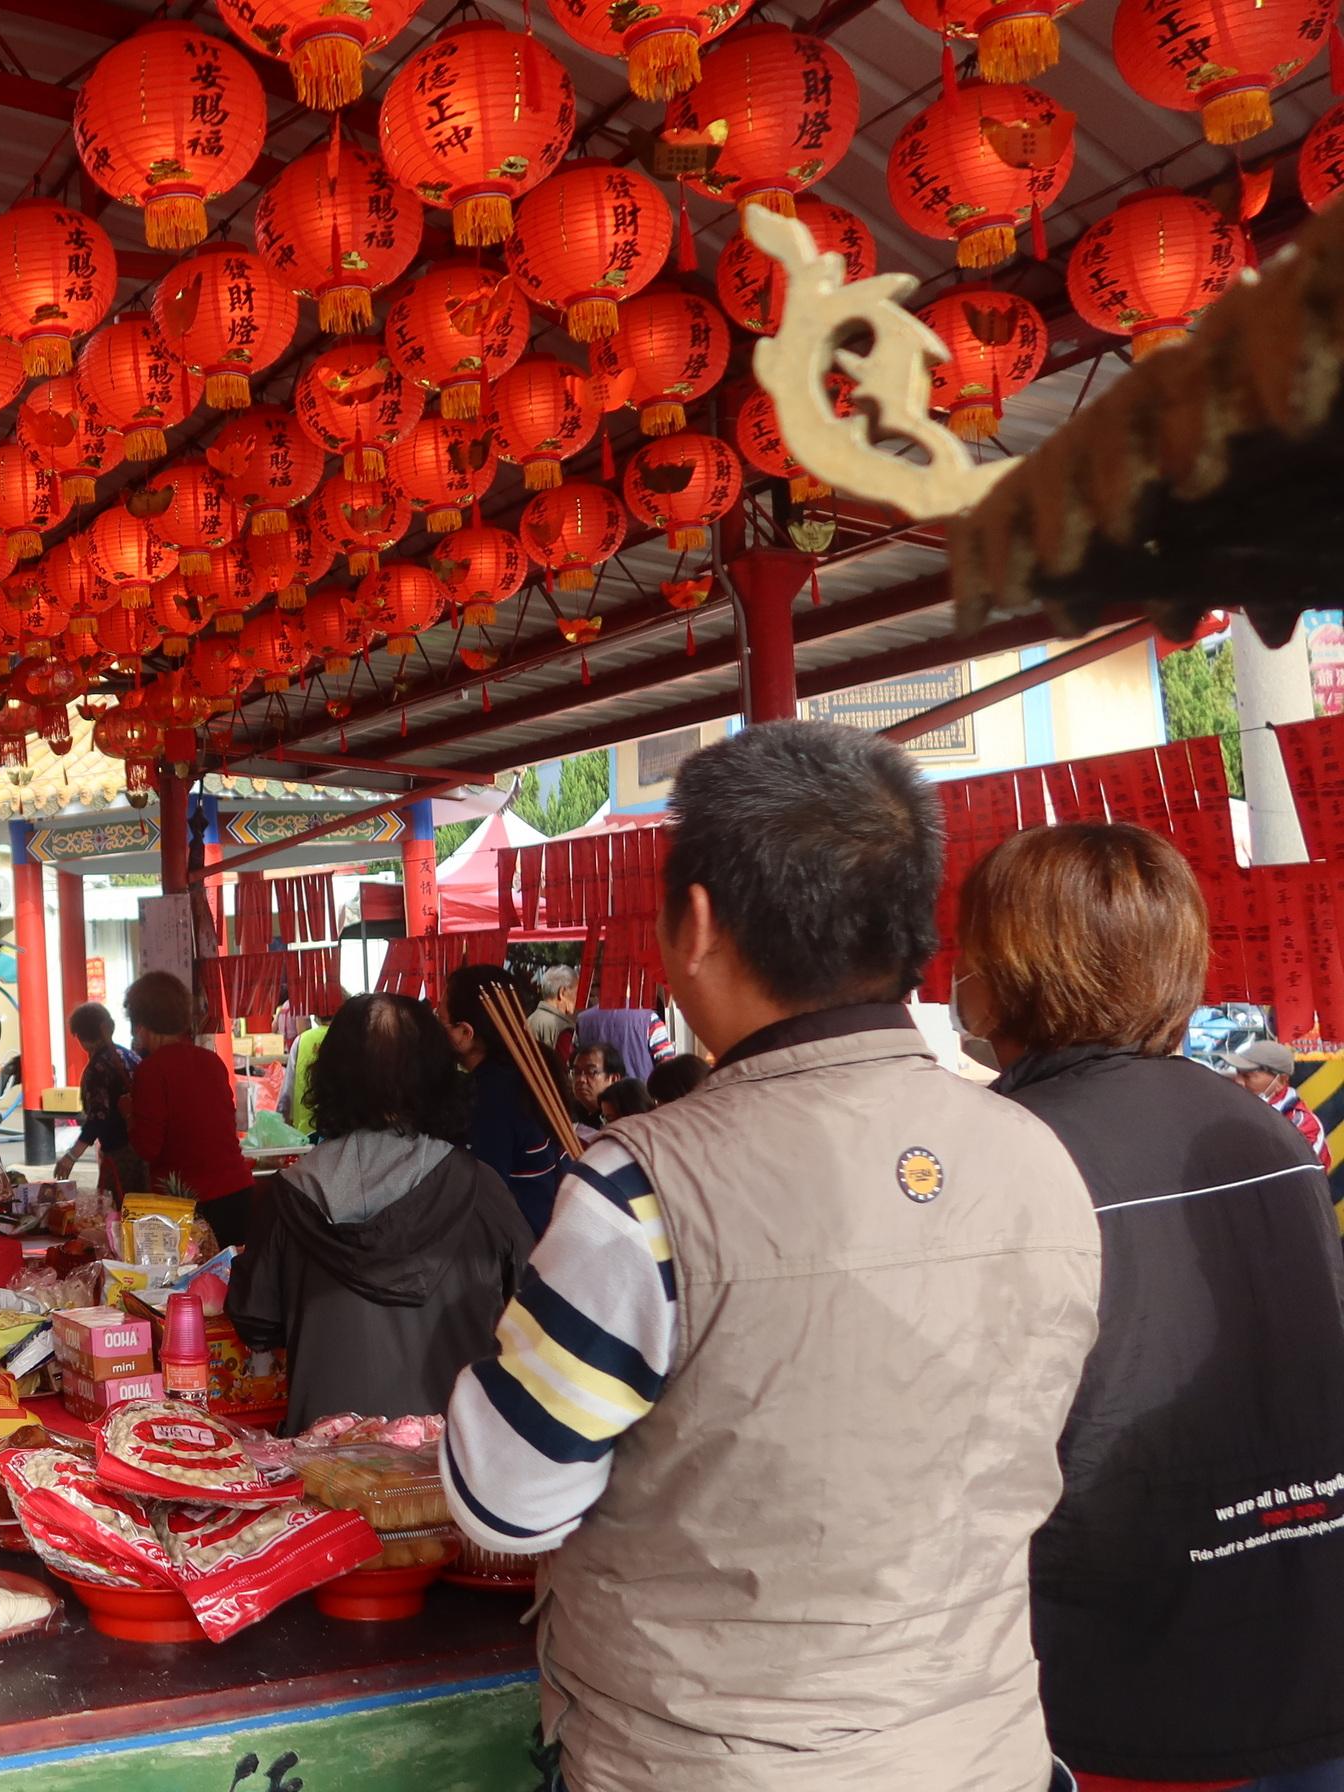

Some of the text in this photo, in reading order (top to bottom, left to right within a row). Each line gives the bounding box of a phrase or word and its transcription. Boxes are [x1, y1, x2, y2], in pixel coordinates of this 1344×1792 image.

[111, 1361, 136, 1373] mini
[1216, 1506, 1235, 1521] we
[1236, 1499, 1255, 1515] are
[1256, 1490, 1273, 1508] all
[1274, 1488, 1288, 1504] in
[1288, 1482, 1314, 1500] this
